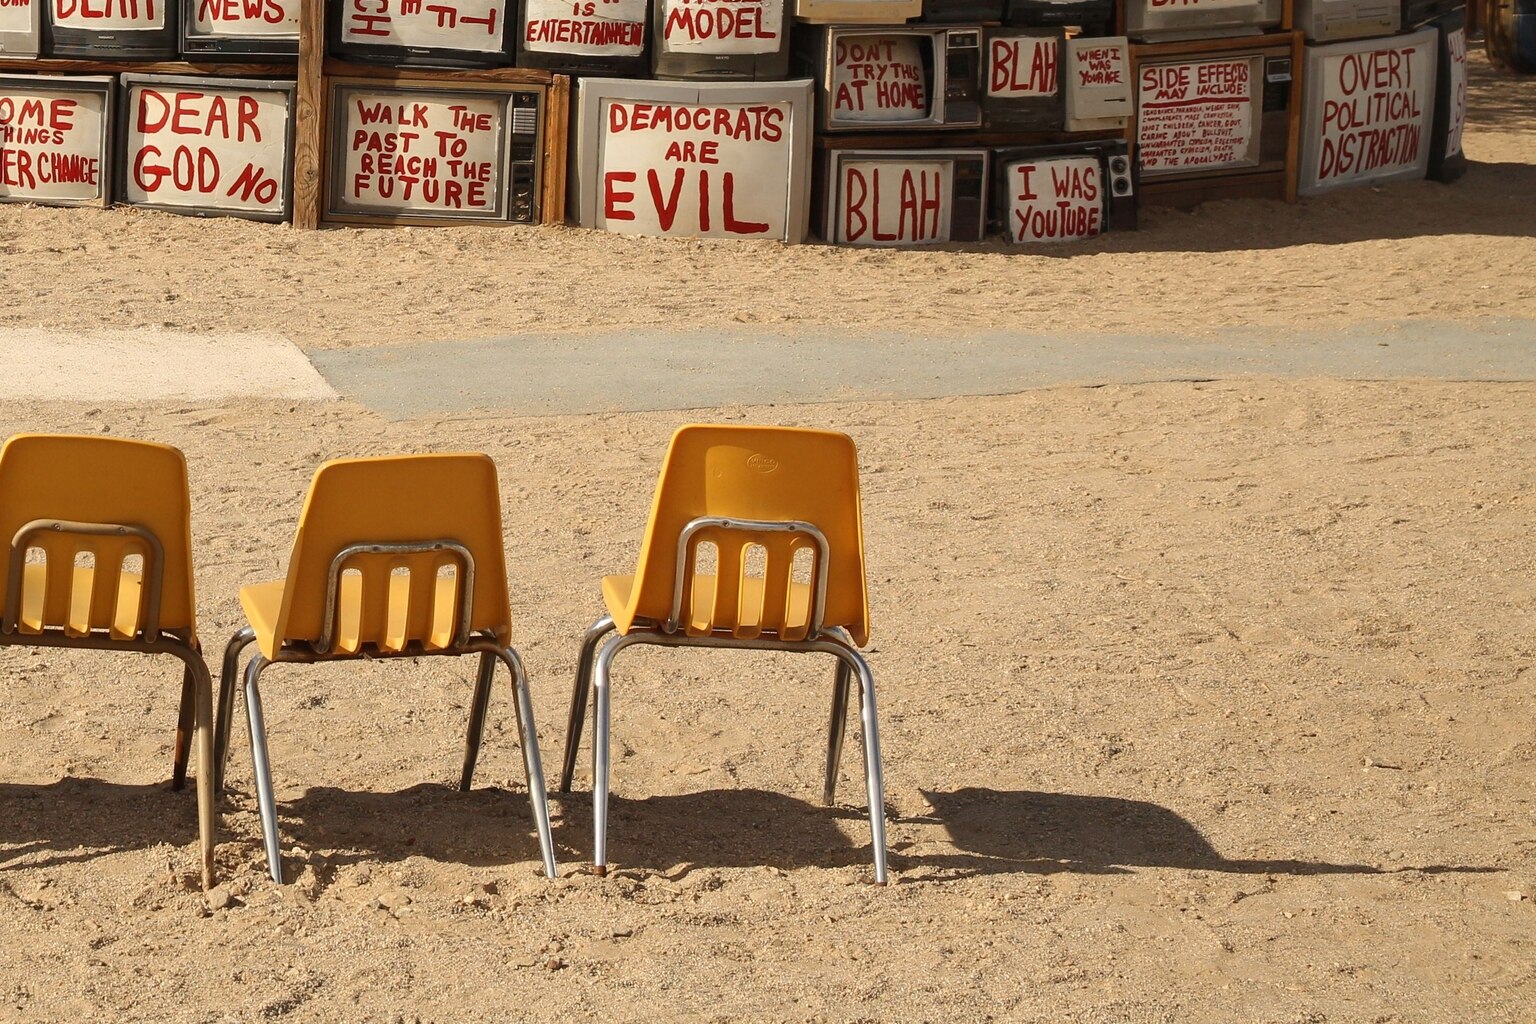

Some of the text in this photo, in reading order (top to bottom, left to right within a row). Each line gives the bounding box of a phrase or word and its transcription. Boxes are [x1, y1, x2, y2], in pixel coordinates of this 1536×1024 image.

[664, 7, 776, 40] MODEL
[836, 40, 897, 65] DON'T
[1077, 48, 1120, 62] WHEN I
[1089, 60, 1111, 71] WAS
[847, 62, 920, 81] TRY THIS
[1143, 63, 1248, 91] SIDE EFFECTS
[1339, 48, 1416, 95] OVERT
[836, 81, 924, 111] AT HOME
[1155, 87, 1188, 99] MAY
[609, 104, 783, 142] DEMOCRATS
[1322, 91, 1420, 135] POLITICAL
[38, 151, 98, 186] CHANGE
[665, 141, 719, 164] ARE
[1319, 124, 1421, 179] DISTRACTION
[1017, 166, 1097, 201] I WAS
[605, 168, 769, 234] EVIL
[846, 168, 941, 242] BLAH
[1016, 201, 1098, 239] YOUTUBE
